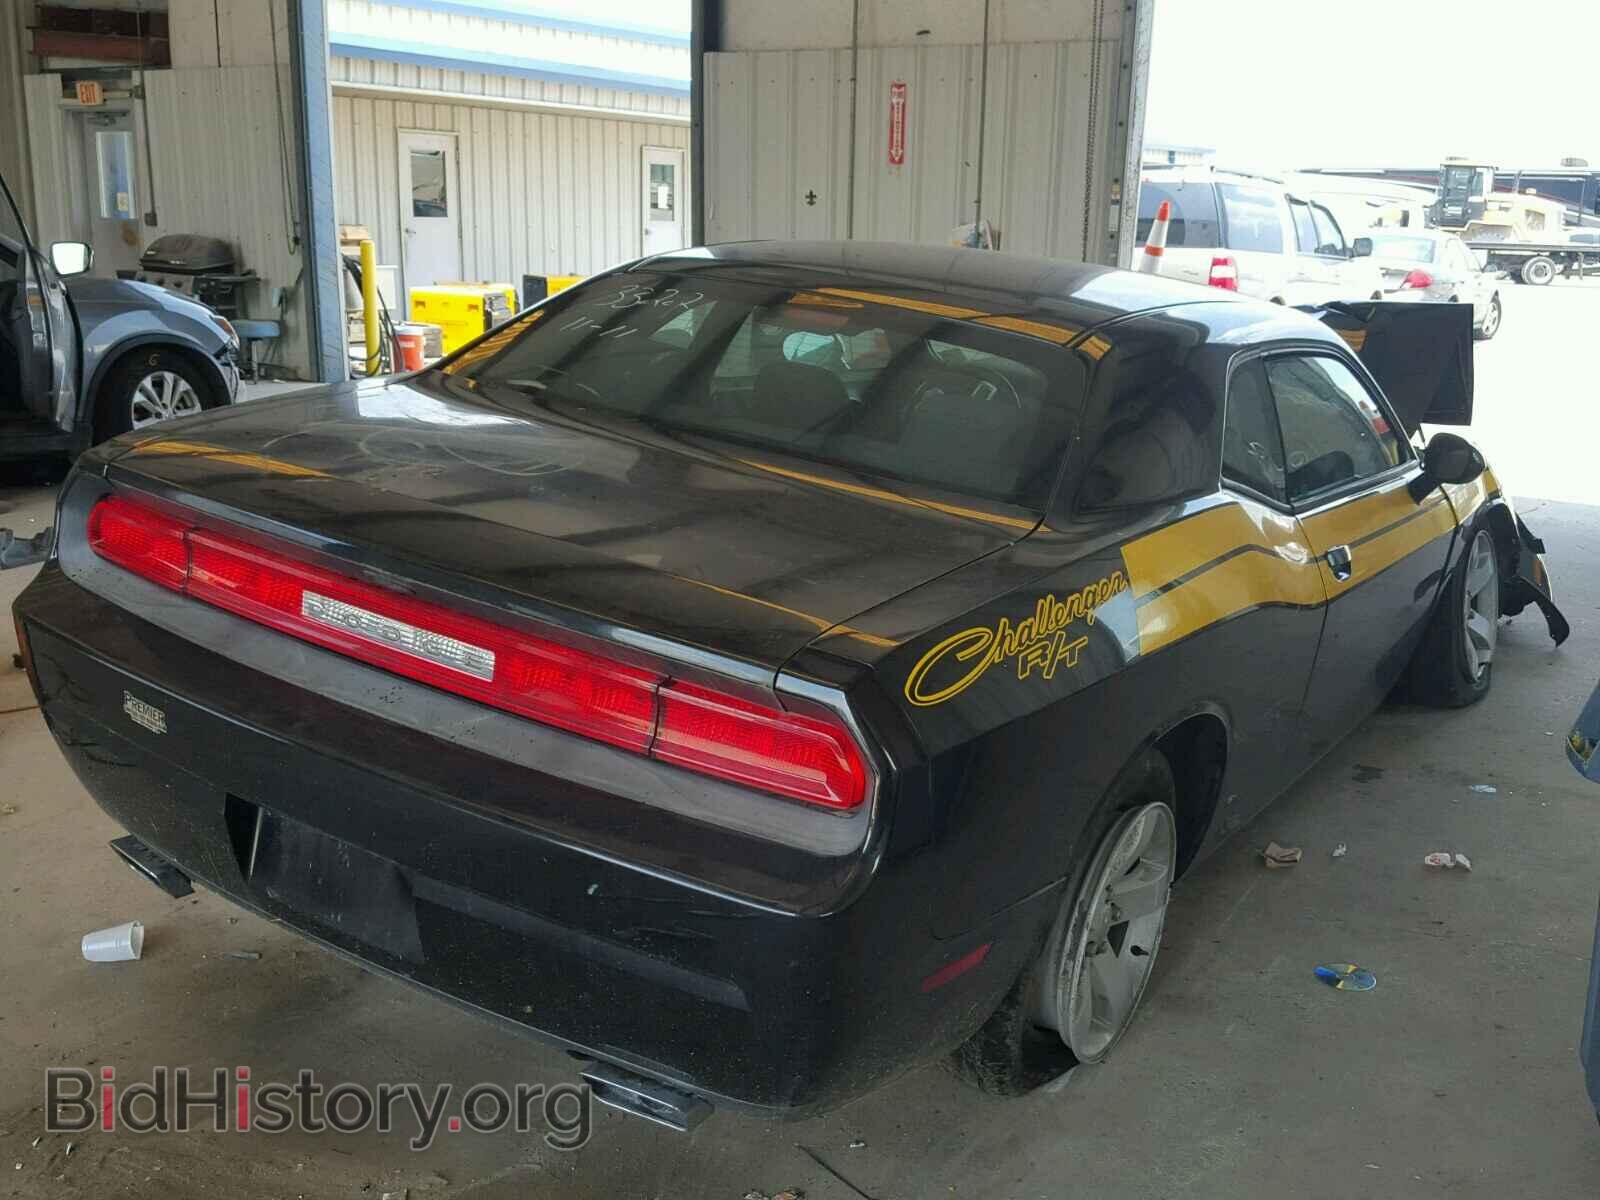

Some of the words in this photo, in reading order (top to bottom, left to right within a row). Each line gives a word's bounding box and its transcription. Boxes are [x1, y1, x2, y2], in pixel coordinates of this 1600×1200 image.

[904, 570, 1128, 706] Challenger
[1018, 630, 1089, 680] R/T
[123, 690, 167, 728] PREMIER
